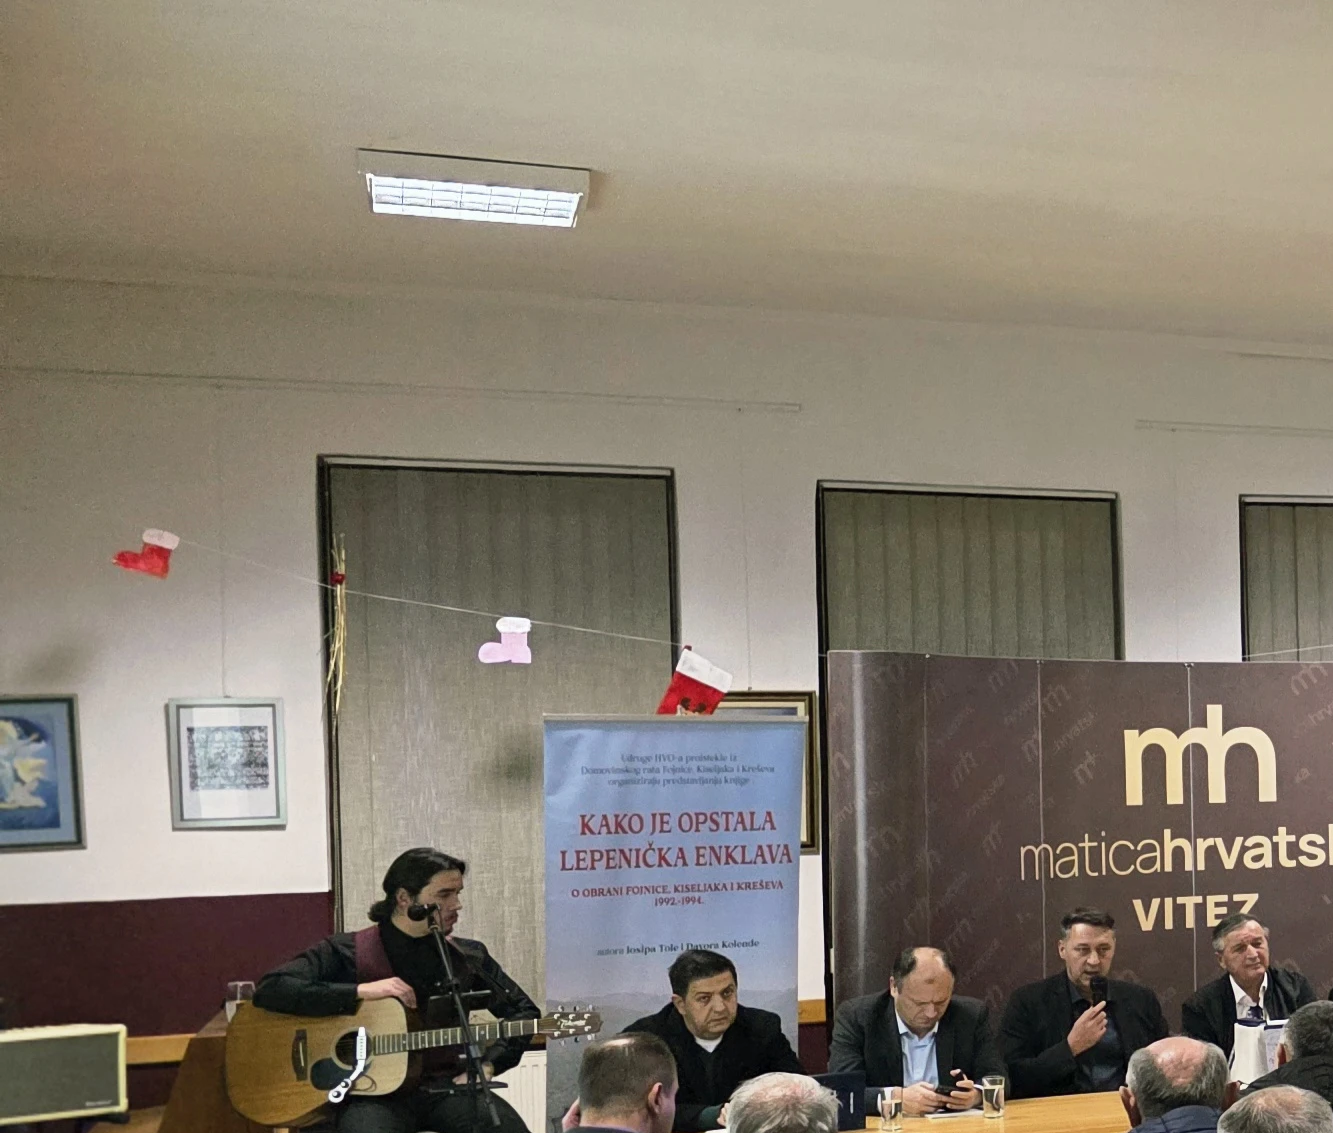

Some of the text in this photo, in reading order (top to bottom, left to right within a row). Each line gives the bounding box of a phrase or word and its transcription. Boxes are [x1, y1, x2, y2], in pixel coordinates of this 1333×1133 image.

[1123, 703, 1278, 807] mh
[579, 810, 777, 836] KAKO JE OPSTALA
[560, 840, 793, 871] LEPENIČKA ENKLAVA
[571, 888, 580, 898] O
[582, 886, 623, 898] OBRANI
[673, 882, 728, 894] KISELJAKA
[736, 879, 784, 891] KREŠEVA
[1132, 893, 1260, 932] VITEZ
[721, 938, 760, 949] Kolende
